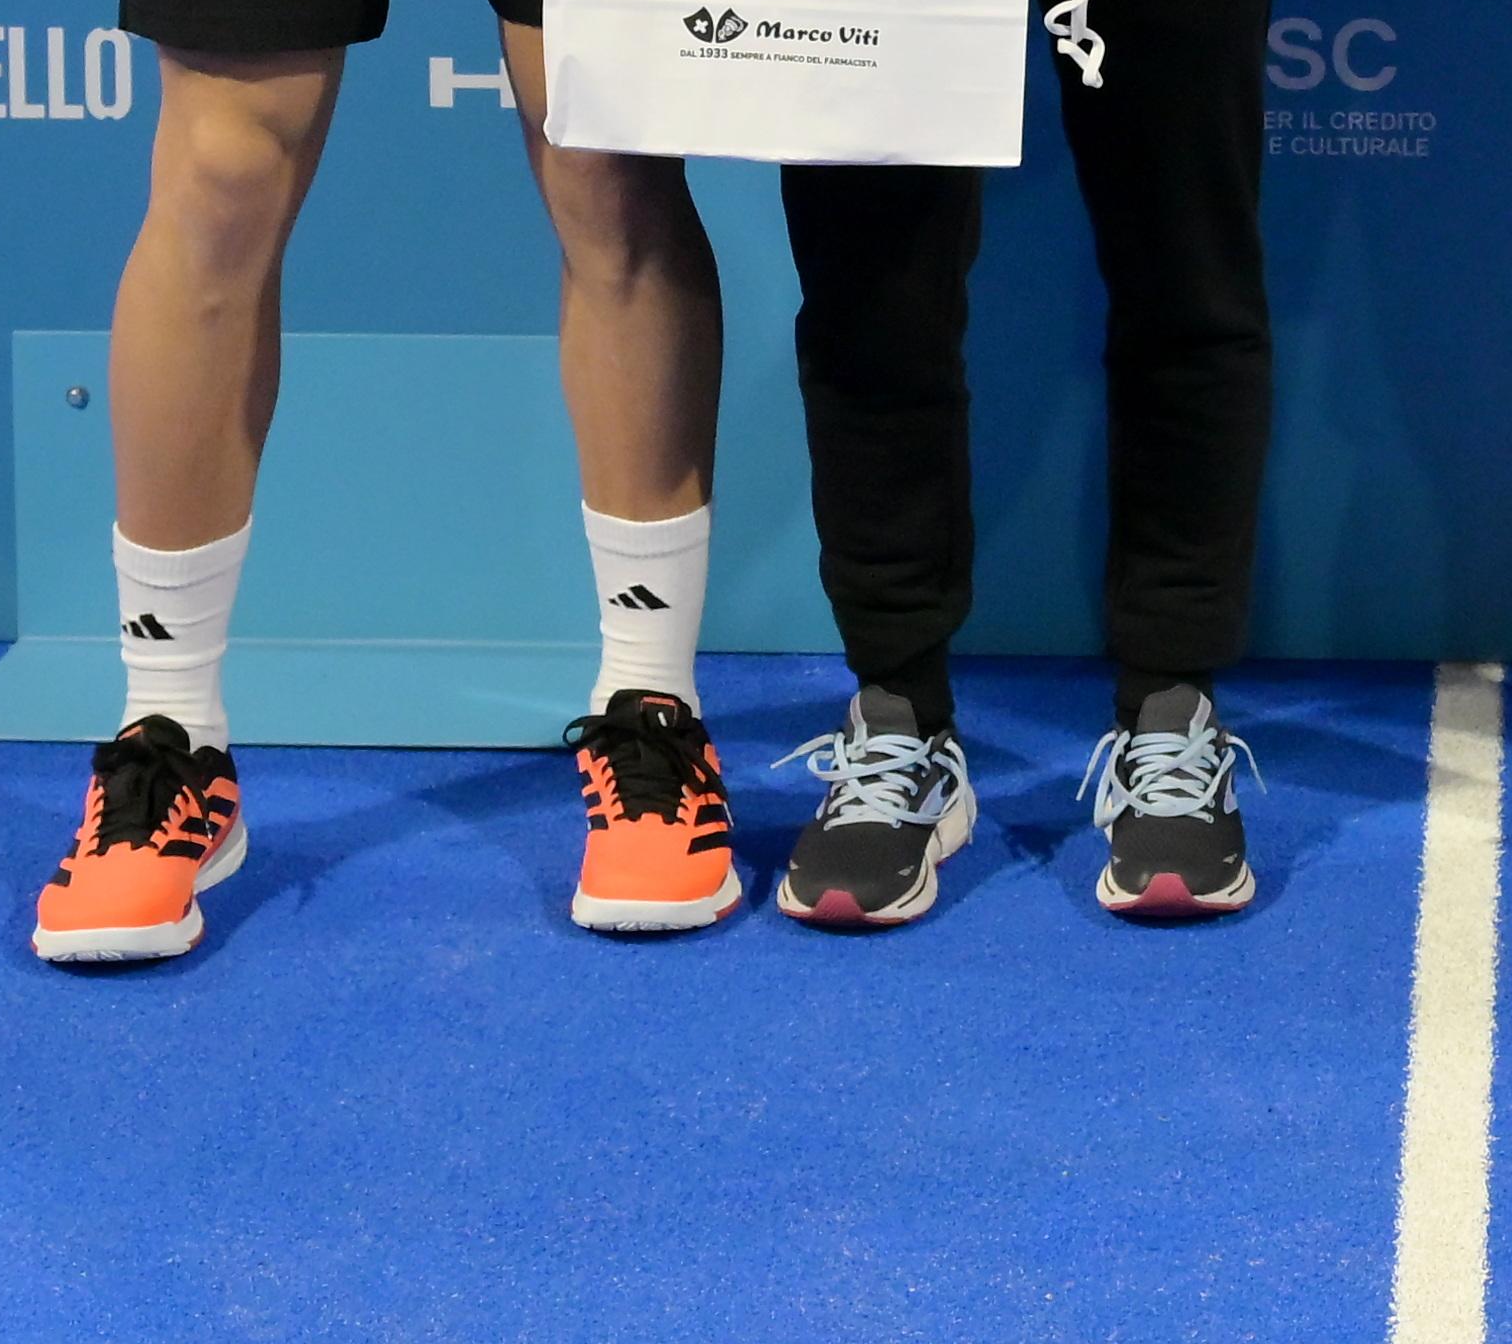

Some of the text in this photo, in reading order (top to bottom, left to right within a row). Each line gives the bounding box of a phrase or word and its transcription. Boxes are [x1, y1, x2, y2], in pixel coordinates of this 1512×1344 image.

[756, 20, 880, 47] Marco Viti
[679, 47, 878, 69] DAL 1933 SEMPRE A FIANCO DEL FARMACISTA
[1264, 16, 1398, 92] SC
[1264, 112, 1437, 133] ER IL CREDITO
[1269, 136, 1430, 157] E CULTURALE
